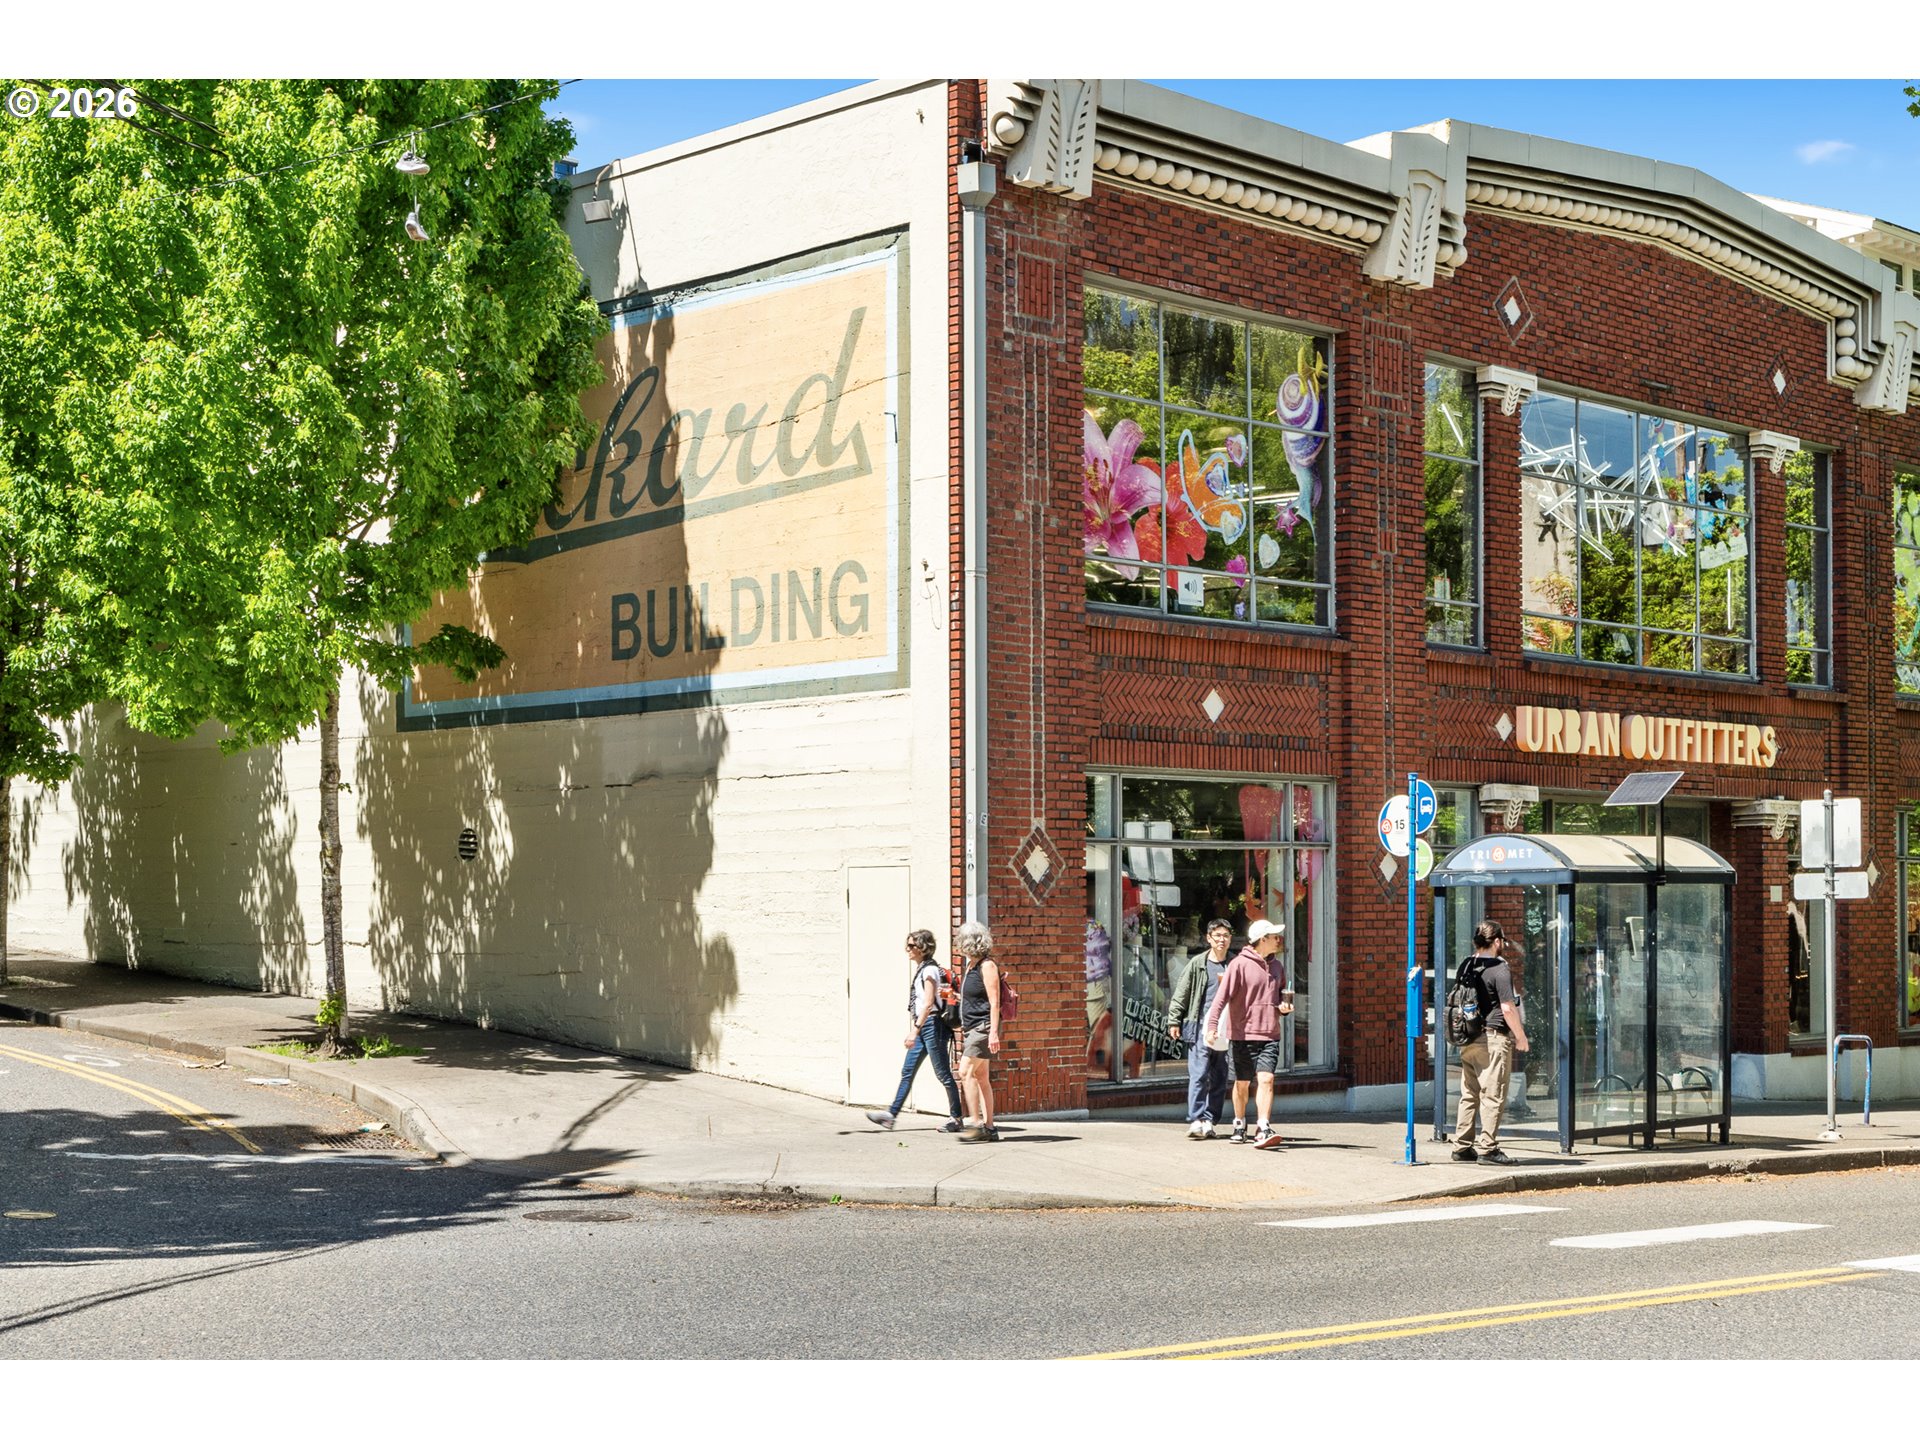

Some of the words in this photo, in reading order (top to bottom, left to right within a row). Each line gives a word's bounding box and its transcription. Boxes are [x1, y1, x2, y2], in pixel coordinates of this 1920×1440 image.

[611, 559, 869, 661] BUILDING
[1516, 705, 1620, 757] URBAN
[1621, 714, 1776, 768] OUTFITTERS
[1394, 819, 1405, 830] 15
[1469, 849, 1490, 860] TRI
[1507, 848, 1533, 859] MET
[1125, 997, 1169, 1035] URBA
[1122, 1016, 1183, 1060] OUTFITTERS
